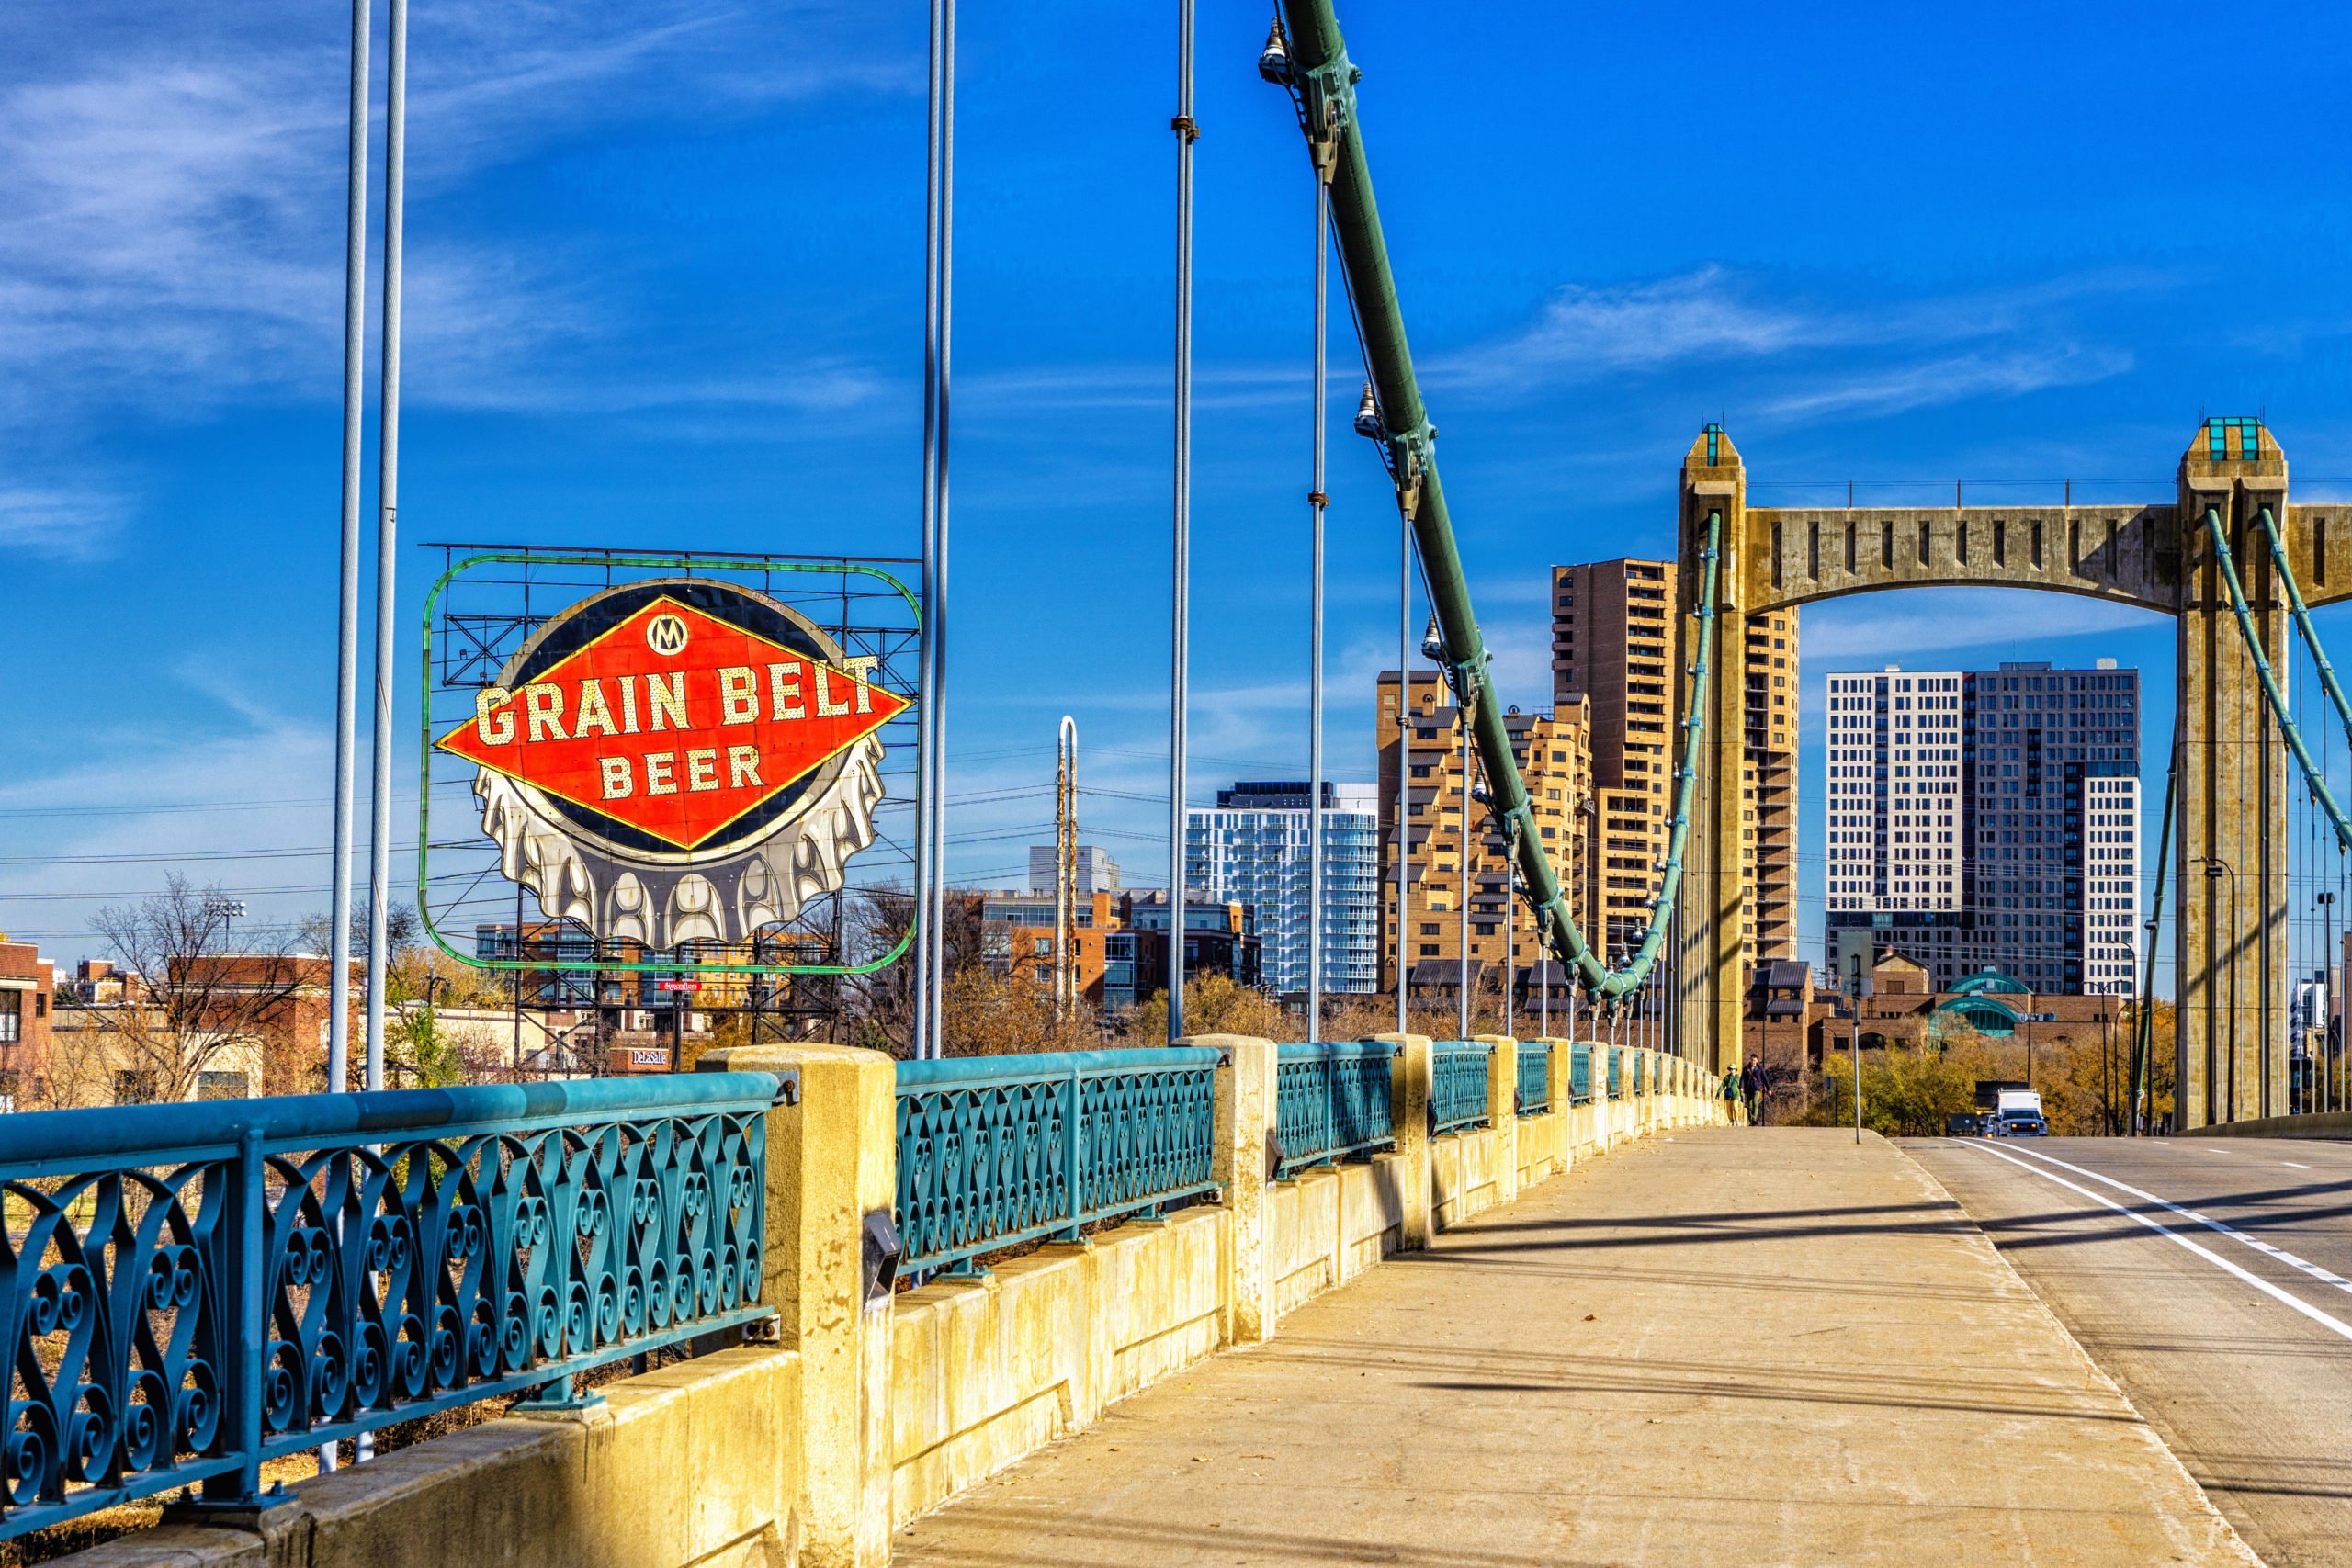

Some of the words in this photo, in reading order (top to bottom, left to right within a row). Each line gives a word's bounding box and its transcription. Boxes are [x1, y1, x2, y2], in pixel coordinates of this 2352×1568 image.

[475, 671, 692, 746] GRAIN
[716, 655, 878, 726] BELT
[597, 745, 766, 800] BEER
[633, 1051, 666, 1064] DeLaSalle
